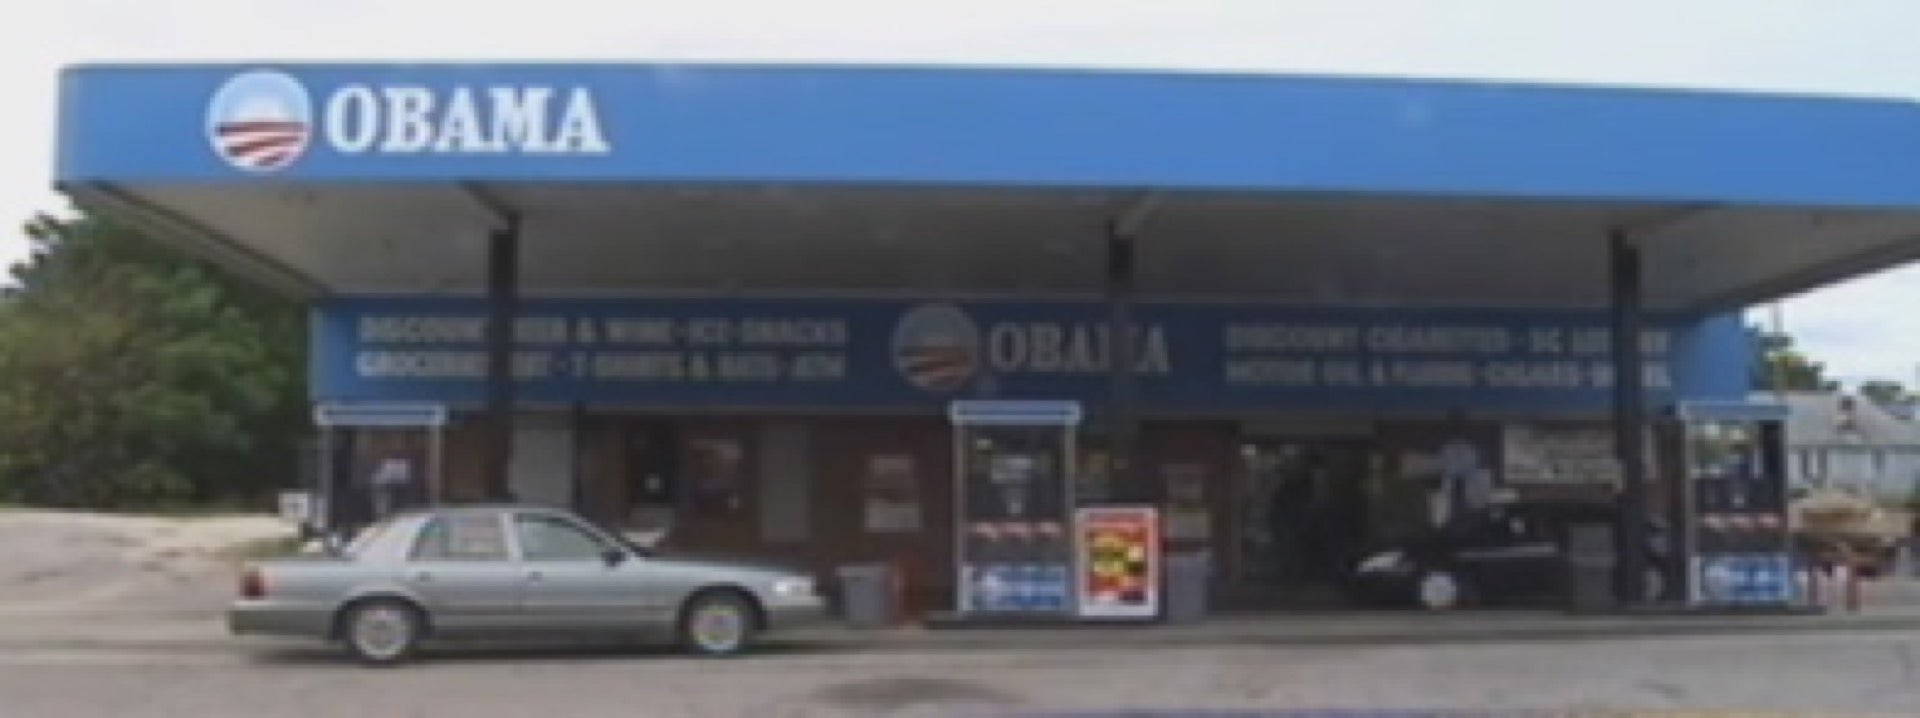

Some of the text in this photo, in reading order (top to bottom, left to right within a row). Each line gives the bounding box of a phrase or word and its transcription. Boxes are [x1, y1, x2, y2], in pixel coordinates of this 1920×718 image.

[324, 84, 611, 152] OBAMA
[508, 317, 567, 342] EER
[1226, 326, 1359, 351] DISCOUNT
